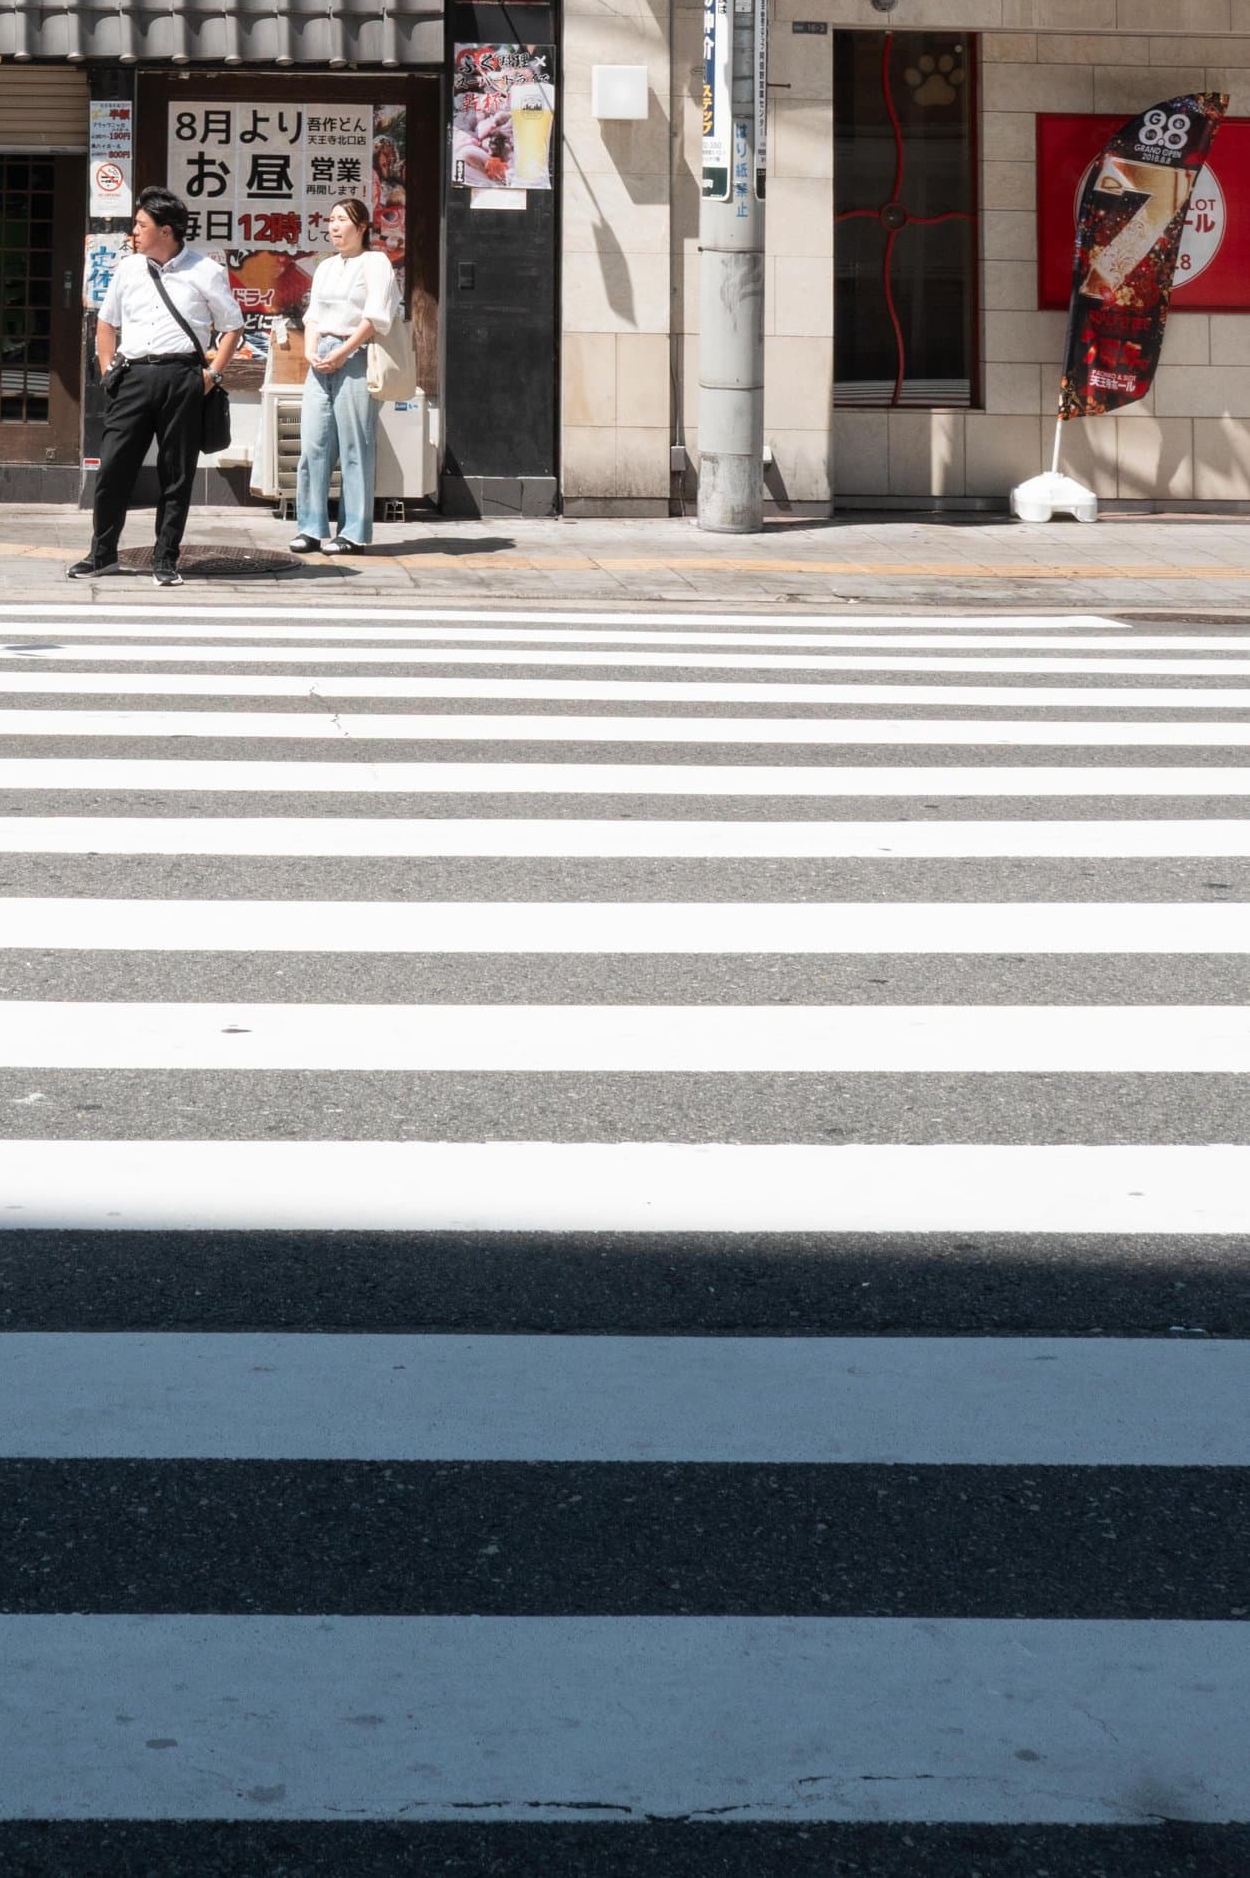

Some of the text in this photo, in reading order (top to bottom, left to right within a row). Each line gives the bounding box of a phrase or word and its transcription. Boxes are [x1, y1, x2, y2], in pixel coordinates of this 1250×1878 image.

[176, 110, 302, 144] 8月より
[307, 117, 366, 132] 吾作どん
[307, 135, 366, 146] 天王寺北口店
[186, 151, 293, 199] お昼
[311, 157, 361, 182] 営業
[735, 123, 749, 218] はり紙禁止
[238, 211, 301, 244] 12時
